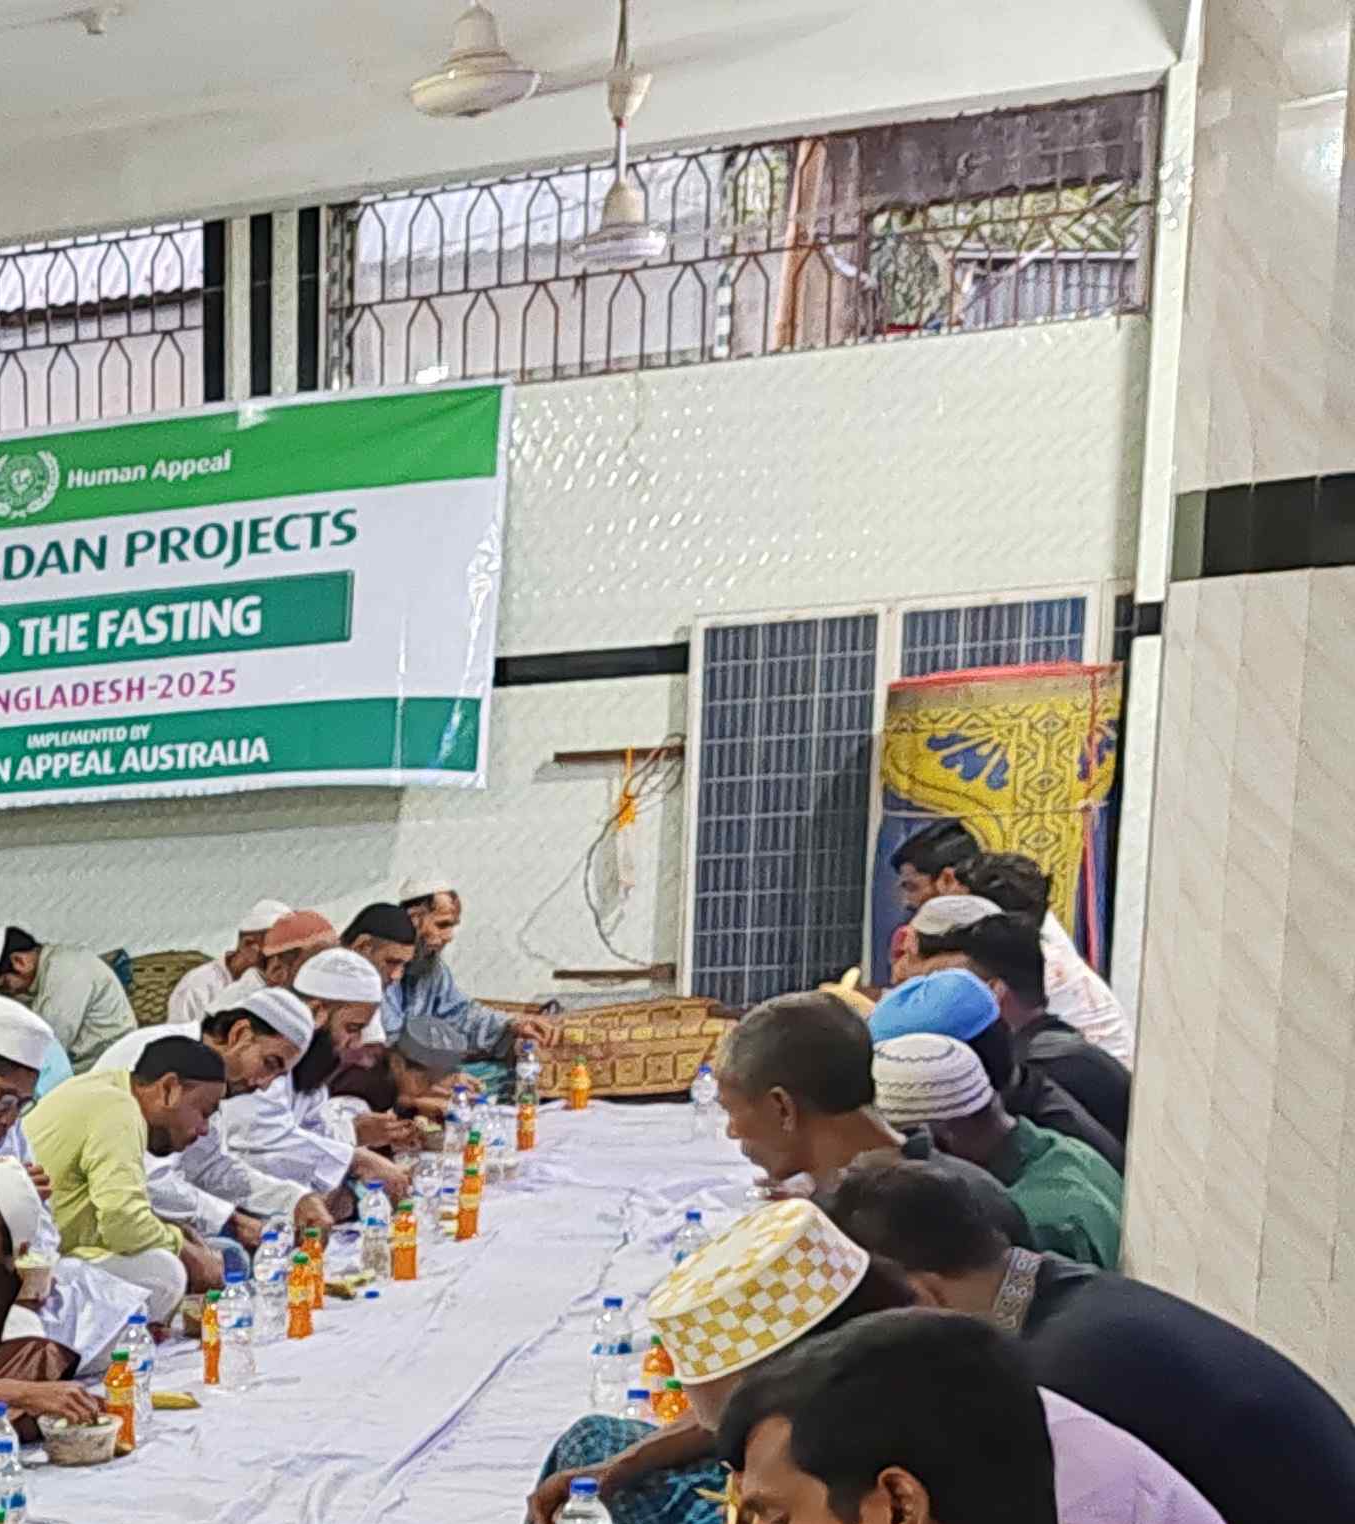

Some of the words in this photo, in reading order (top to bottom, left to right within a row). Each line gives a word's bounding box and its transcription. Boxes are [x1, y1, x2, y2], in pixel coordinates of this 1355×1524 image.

[67, 465, 147, 488] Human
[152, 448, 232, 482] Appeal
[125, 508, 358, 569] PROJECTS
[19, 608, 89, 656] THE
[97, 594, 262, 649] FASTING
[26, 725, 128, 749] IMPLEMENTED
[129, 722, 151, 741] BY
[16, 744, 115, 782] APPEAL
[119, 736, 271, 774] AUSTRALIA
